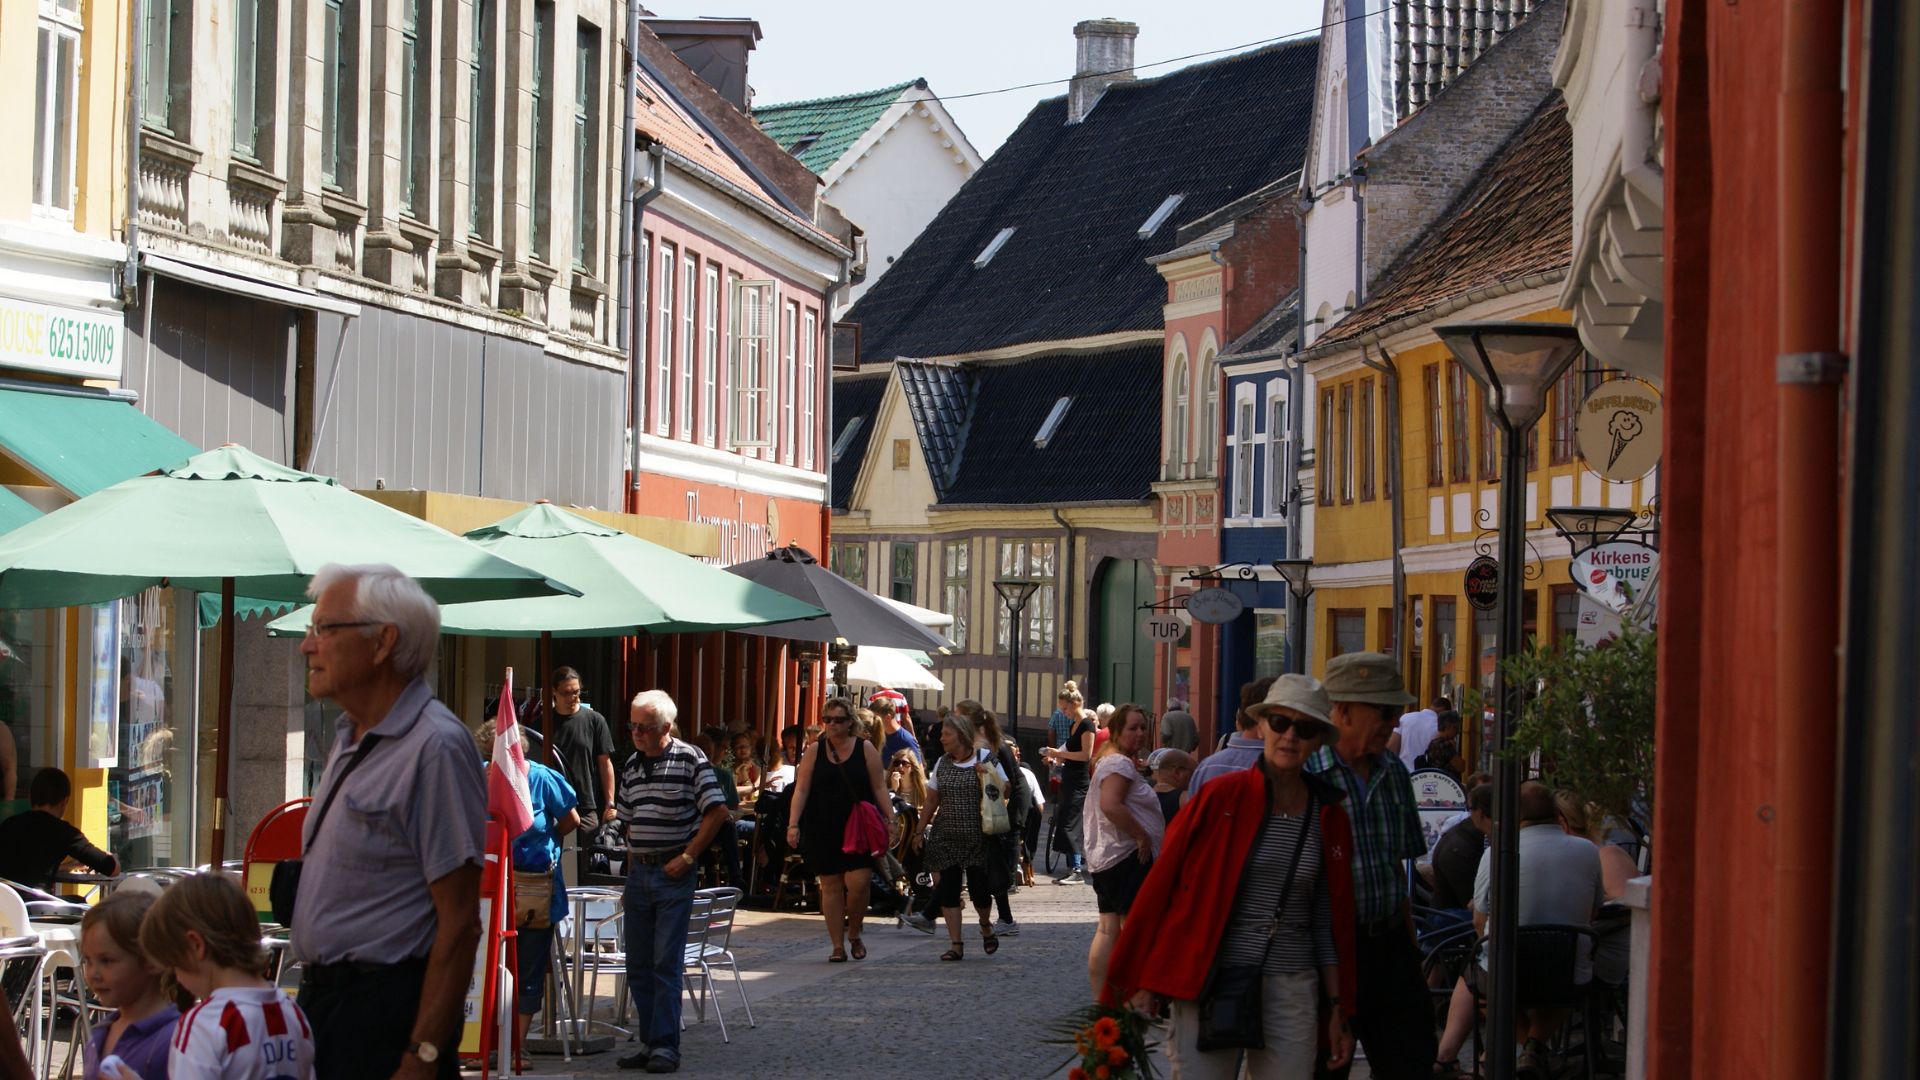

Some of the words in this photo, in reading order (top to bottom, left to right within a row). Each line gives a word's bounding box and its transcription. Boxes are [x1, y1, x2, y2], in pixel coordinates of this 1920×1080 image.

[49, 316, 114, 365] 62515009
[1591, 551, 1650, 565] Kirkens
[1602, 565, 1651, 581] nbrug
[1150, 622, 1179, 638] TUR
[1433, 774, 1452, 785] KAFFE
